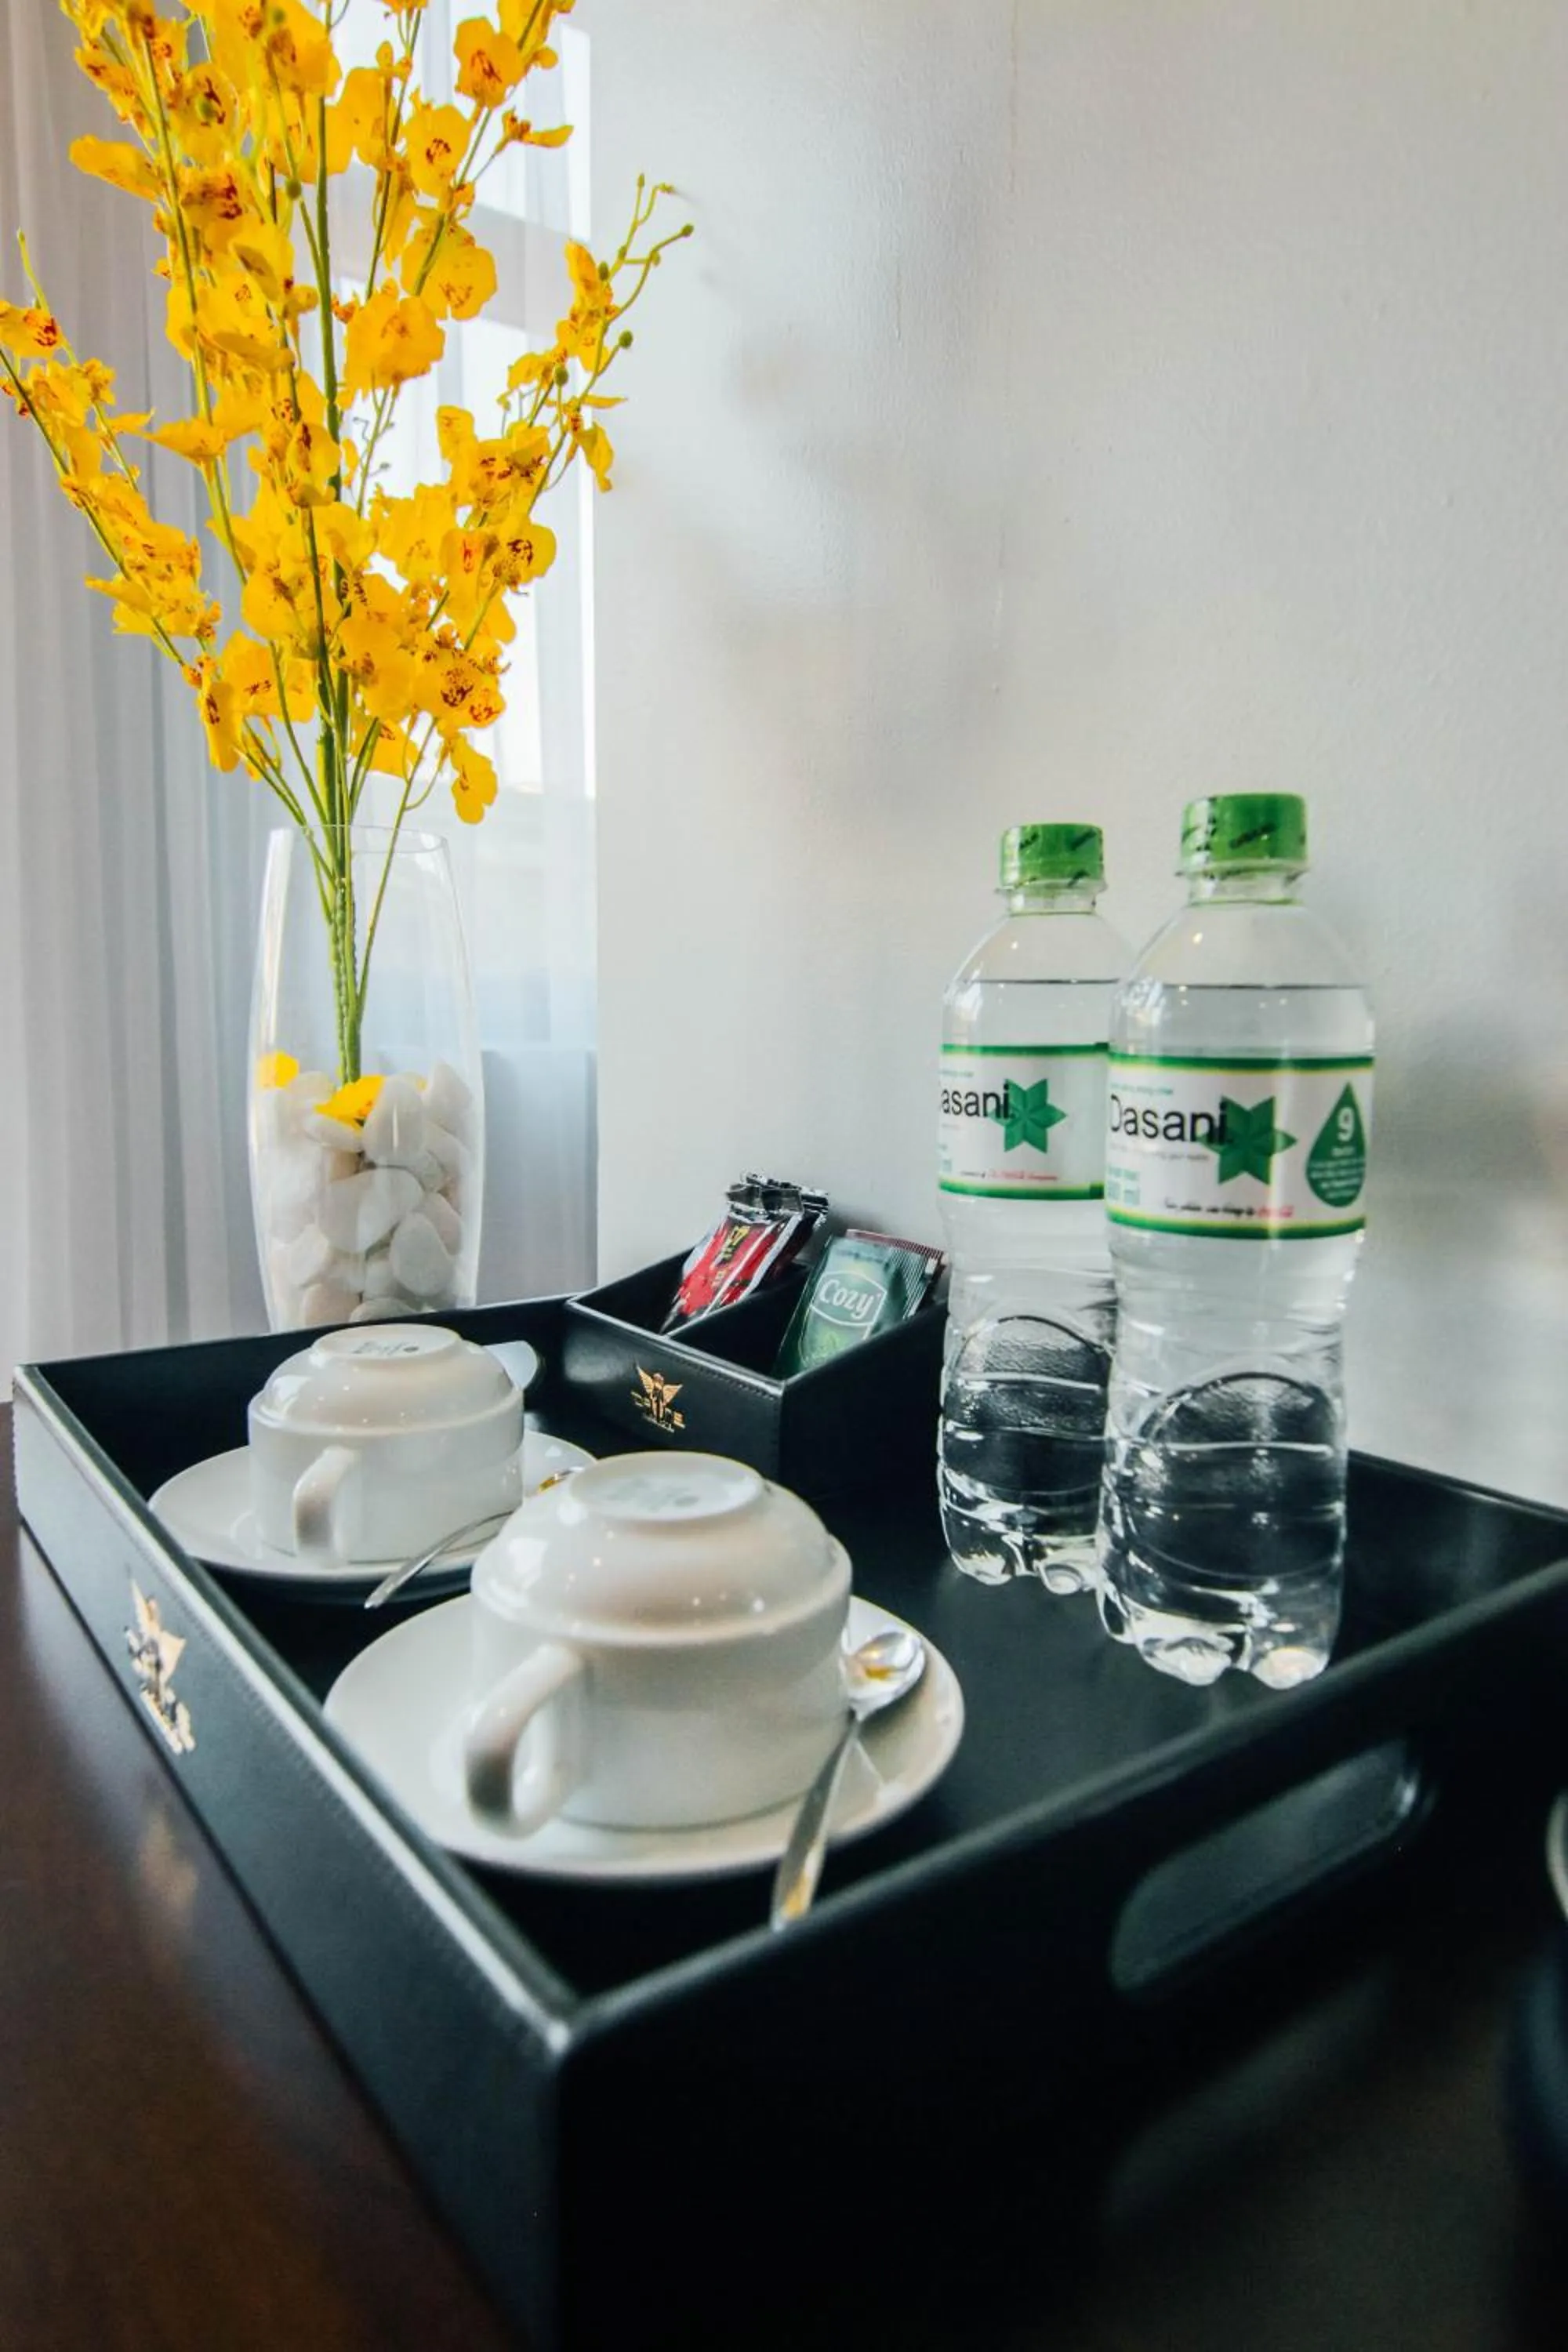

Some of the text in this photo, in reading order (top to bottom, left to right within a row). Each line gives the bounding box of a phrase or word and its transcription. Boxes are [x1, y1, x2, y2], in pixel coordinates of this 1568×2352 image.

[940, 1083, 1010, 1120] asani
[1109, 1094, 1228, 1145] Dasani
[1337, 1106, 1356, 1142] 9
[818, 1279, 874, 1320] Cozy
